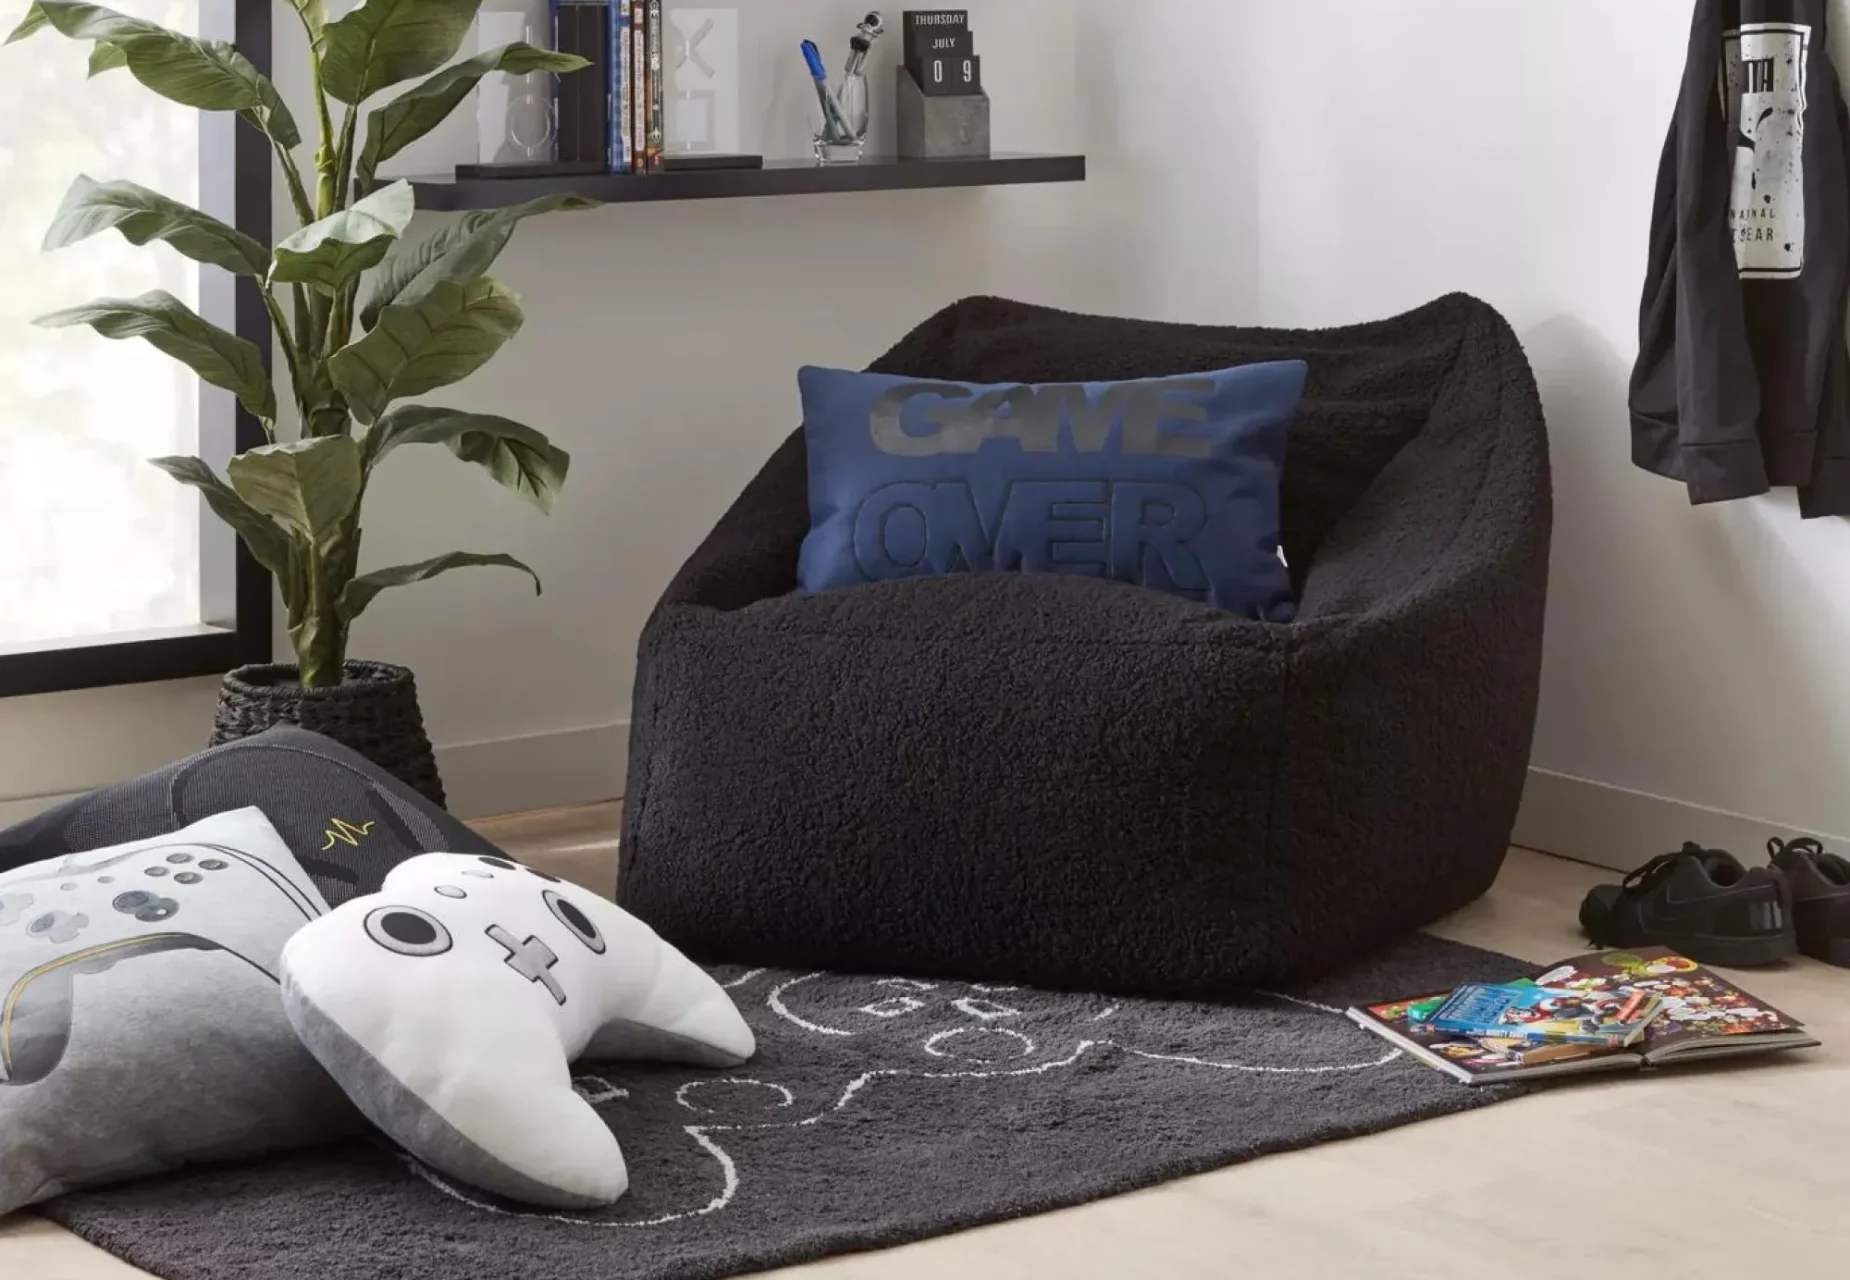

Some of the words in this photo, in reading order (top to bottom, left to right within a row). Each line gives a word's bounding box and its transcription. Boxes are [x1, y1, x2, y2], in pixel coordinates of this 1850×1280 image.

[915, 14, 965, 25] THURSDAY
[932, 37, 956, 49] JULY
[869, 378, 1216, 459] GAME
[853, 480, 1214, 590] OVER
